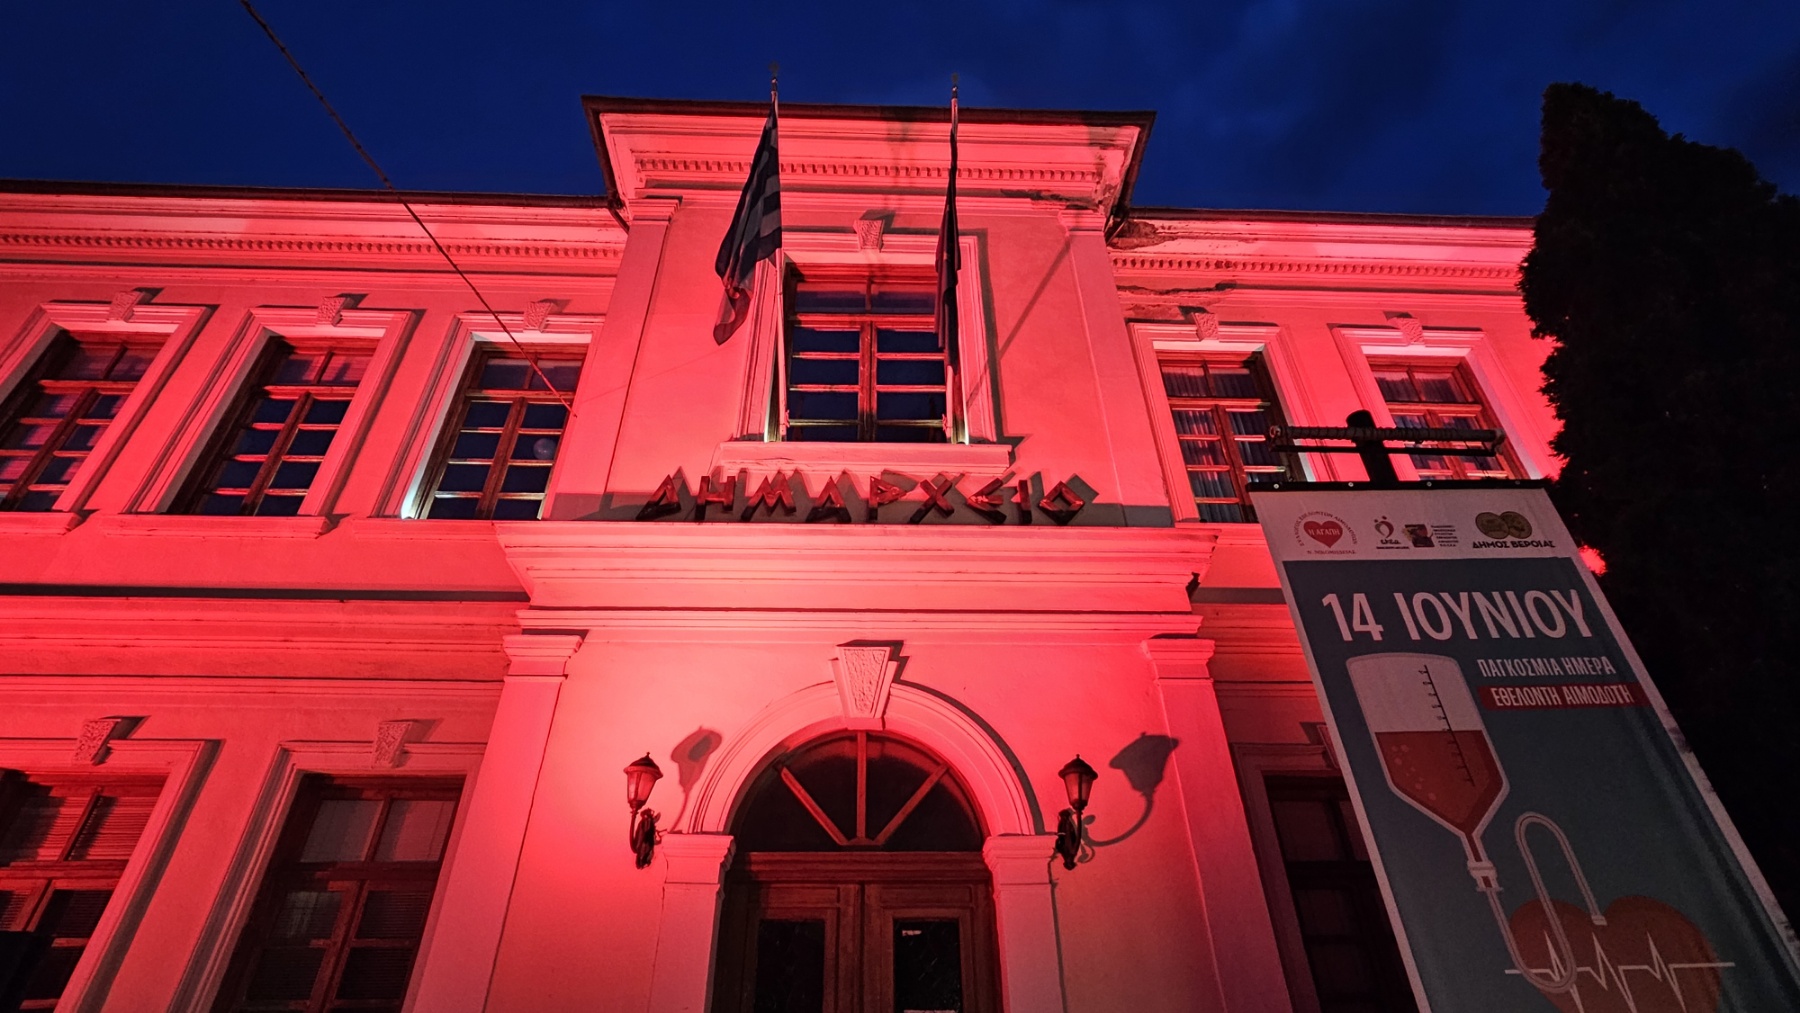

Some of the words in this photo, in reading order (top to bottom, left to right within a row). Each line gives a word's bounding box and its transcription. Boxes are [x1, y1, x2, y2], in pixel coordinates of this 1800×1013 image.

[635, 473, 1084, 525] ΔΗΜΑΡΧΕΙΟ
[1316, 528, 1341, 536] ΑΓΑΠΗ
[1472, 541, 1510, 549] ΔΗΜΟΣ
[1510, 540, 1556, 549] ΒΕΡΟΙΑΣ
[1321, 593, 1384, 641] 14
[1393, 589, 1593, 641] ΙΟΥΝΙΟΥ
[1476, 658, 1565, 678] ΠΑΓΚΟΣΜΙΑ
[1560, 655, 1617, 675] ΗΜΕΡΑ
[1490, 687, 1562, 707] ΕΘΕΛΟΝΤΗ
[1562, 684, 1635, 705] ΑΙΜΟΔΟΤΗ
